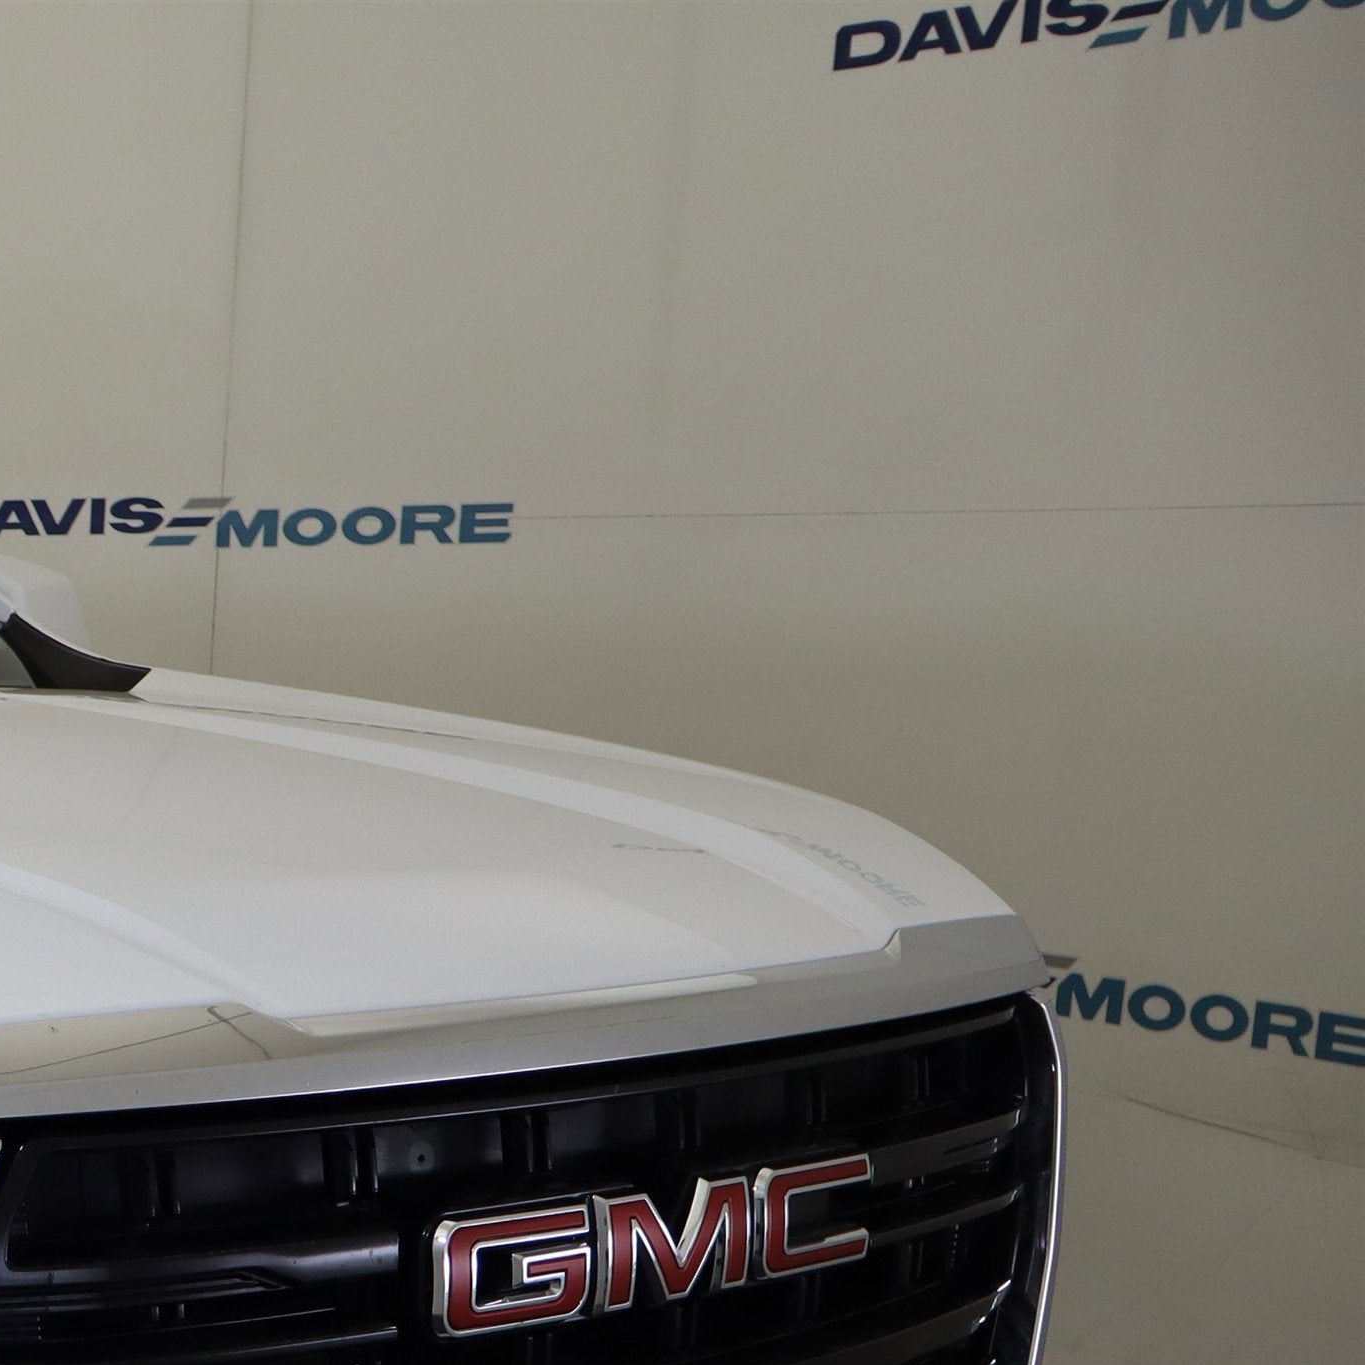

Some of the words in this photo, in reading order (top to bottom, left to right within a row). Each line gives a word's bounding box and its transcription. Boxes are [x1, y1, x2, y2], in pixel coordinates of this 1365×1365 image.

[832, 0, 1110, 71] DAVIS
[214, 503, 514, 548] MOORE
[1055, 973, 1365, 1067] MOORE
[433, 1153, 871, 1338] GMC
